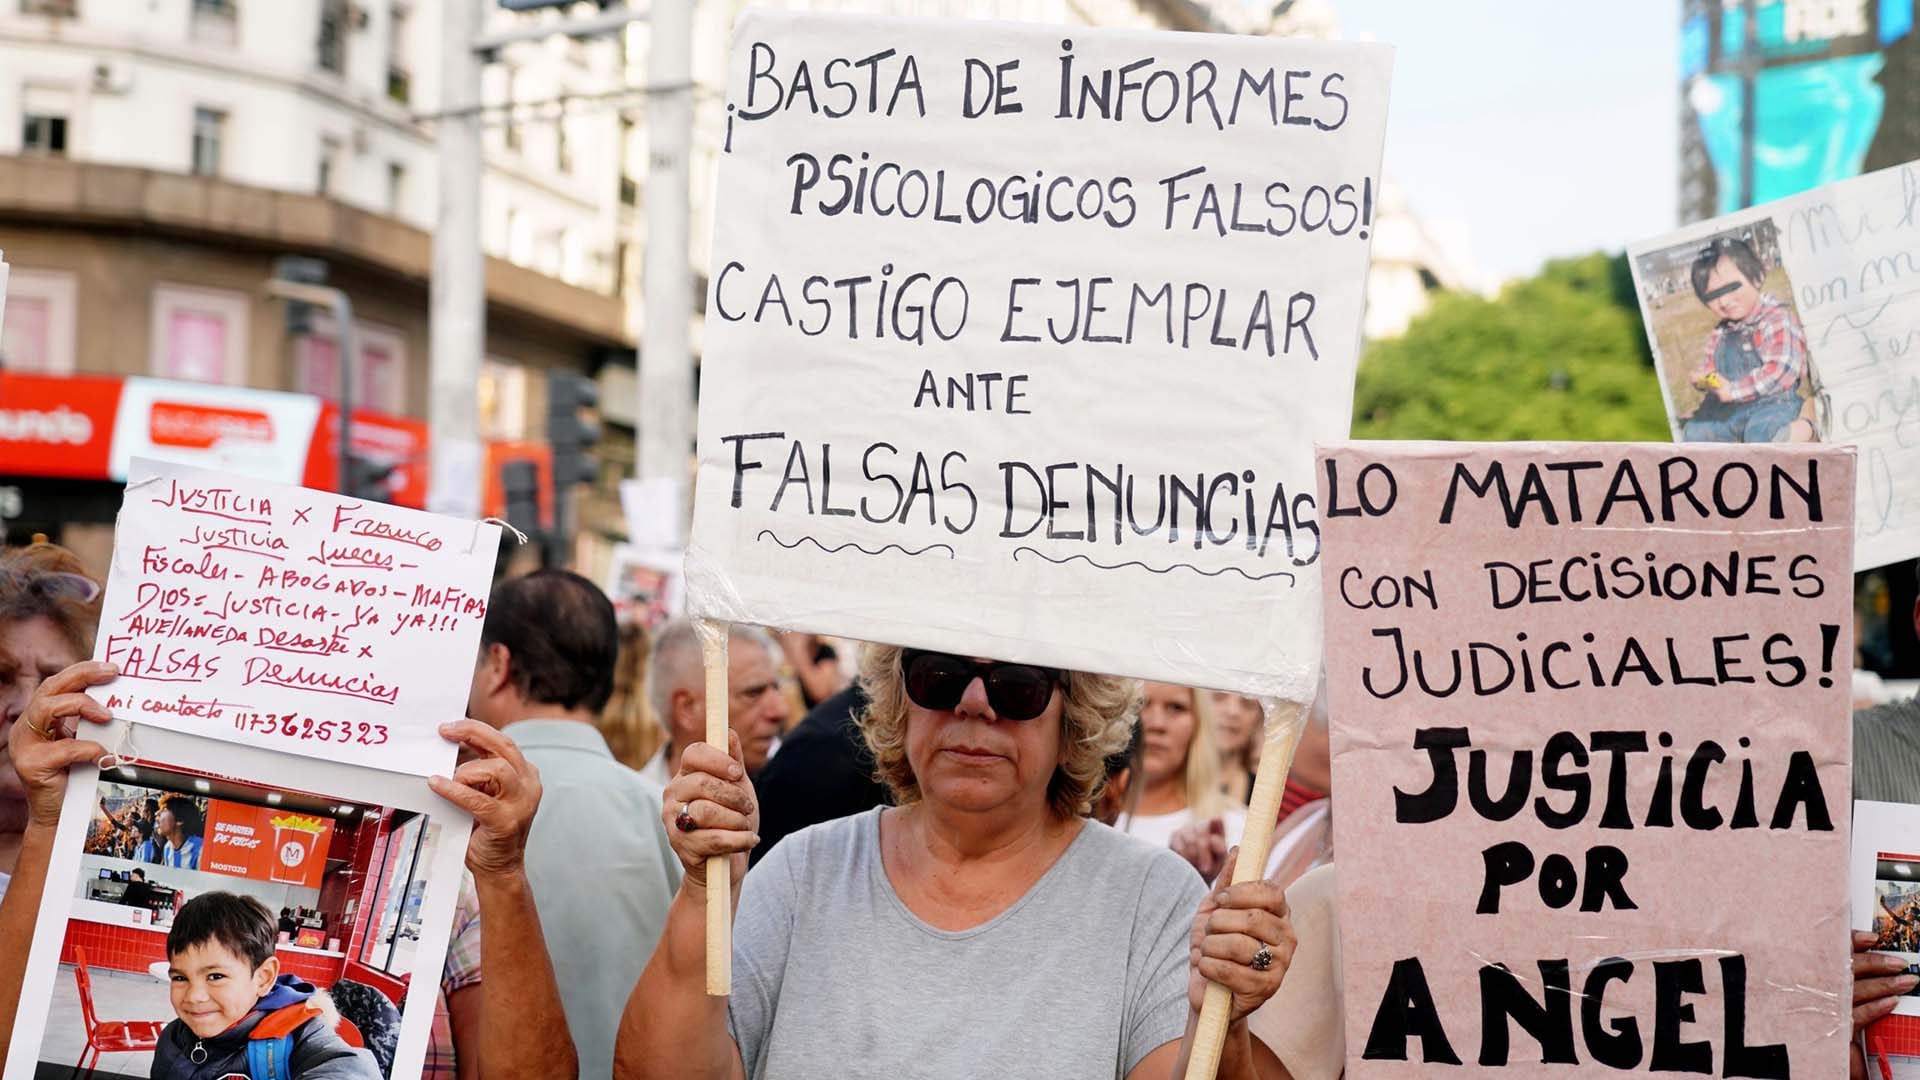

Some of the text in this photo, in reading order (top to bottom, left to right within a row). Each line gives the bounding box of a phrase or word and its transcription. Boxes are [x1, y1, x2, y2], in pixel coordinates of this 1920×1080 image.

[962, 58, 1023, 119] DE
[1159, 166, 1372, 240] FALSOS!
[1000, 277, 1320, 360] EJEMPLAR
[914, 369, 1031, 415] ANTE
[721, 432, 978, 535] FALSAS
[1325, 458, 1398, 518] LO
[1439, 458, 1824, 528] MATARON
[1340, 566, 1438, 610] CON
[105, 634, 221, 678] FALSAS
[1476, 840, 1639, 915] POR
[1362, 953, 1790, 1080] ANGEL
